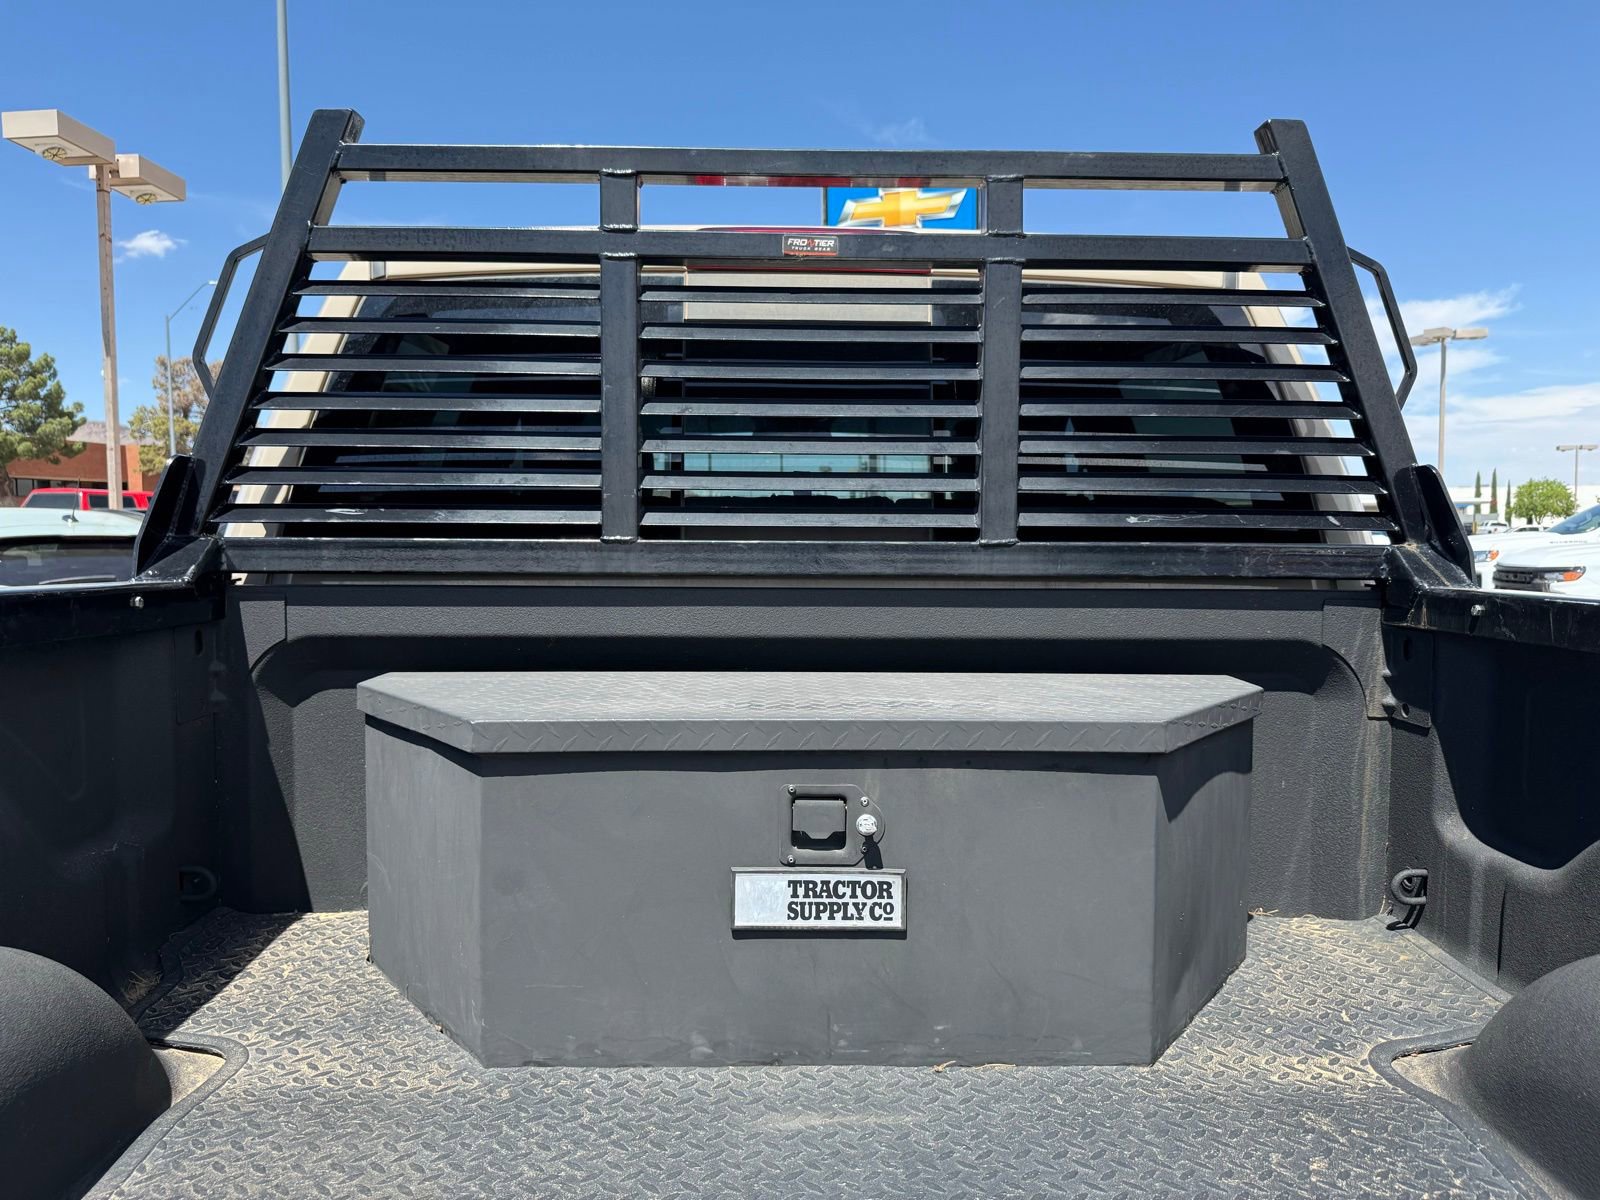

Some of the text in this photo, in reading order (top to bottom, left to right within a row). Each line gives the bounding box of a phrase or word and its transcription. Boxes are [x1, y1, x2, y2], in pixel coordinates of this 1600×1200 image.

[787, 238, 835, 247] FRONTIER
[787, 880, 894, 900] TRACTOR
[787, 901, 867, 921] SUPPLY
